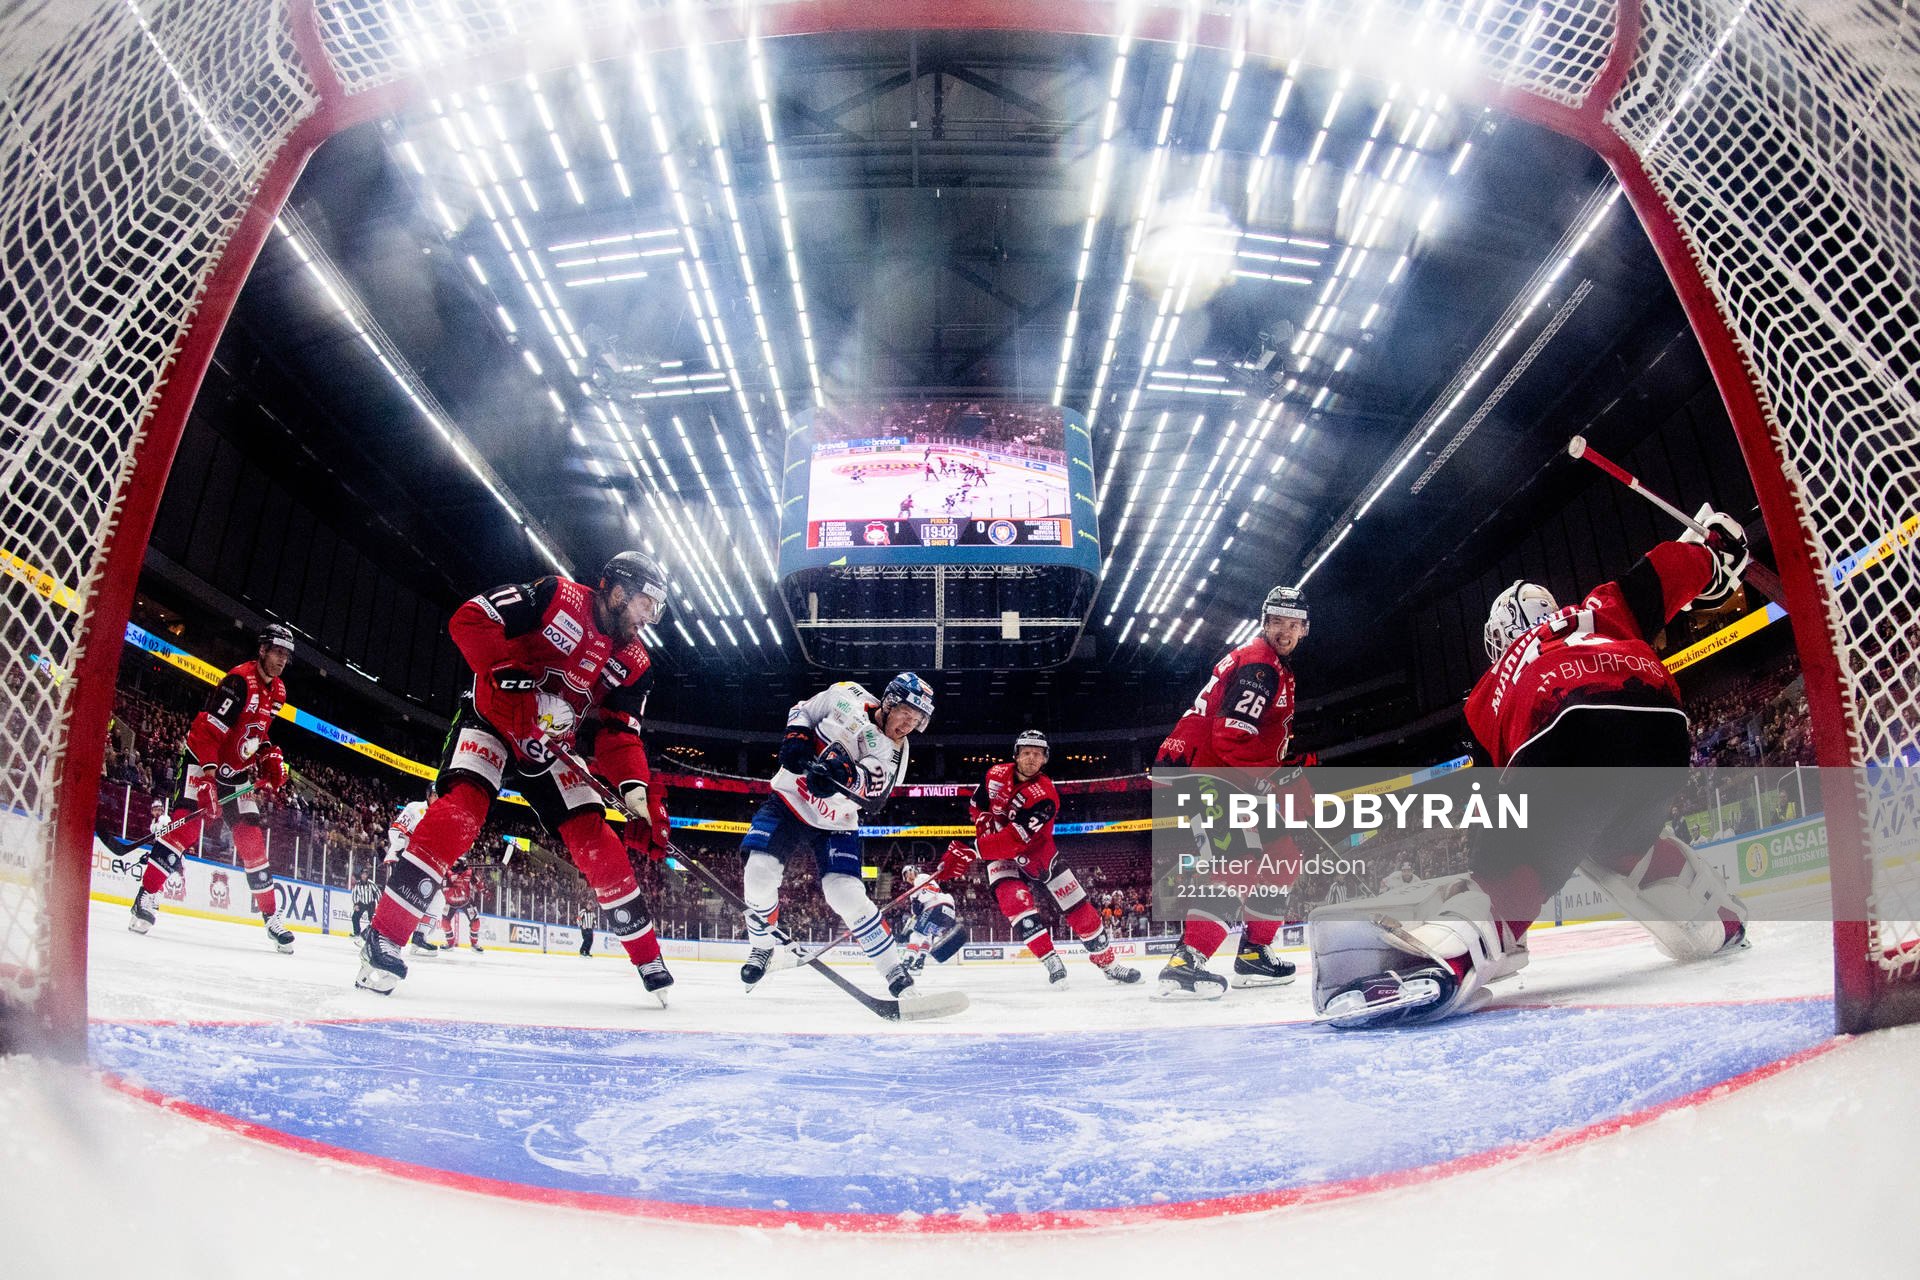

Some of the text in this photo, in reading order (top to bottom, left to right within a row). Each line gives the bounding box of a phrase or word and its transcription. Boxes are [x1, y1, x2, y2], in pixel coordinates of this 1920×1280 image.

[894, 522, 900, 534] 1
[924, 526, 955, 538] 19:02
[976, 521, 985, 533] 0
[560, 595, 581, 613] HOTEL
[544, 627, 573, 654] DOXA
[1667, 630, 1738, 671] tmaskinservice.se
[1559, 652, 1664, 680] BJURFORS
[500, 680, 536, 689] CC
[217, 698, 233, 716] 9
[1234, 690, 1266, 719] 26
[923, 786, 959, 797] KVALITET
[155, 817, 186, 839] BAUER
[1565, 890, 1608, 909] MALM
